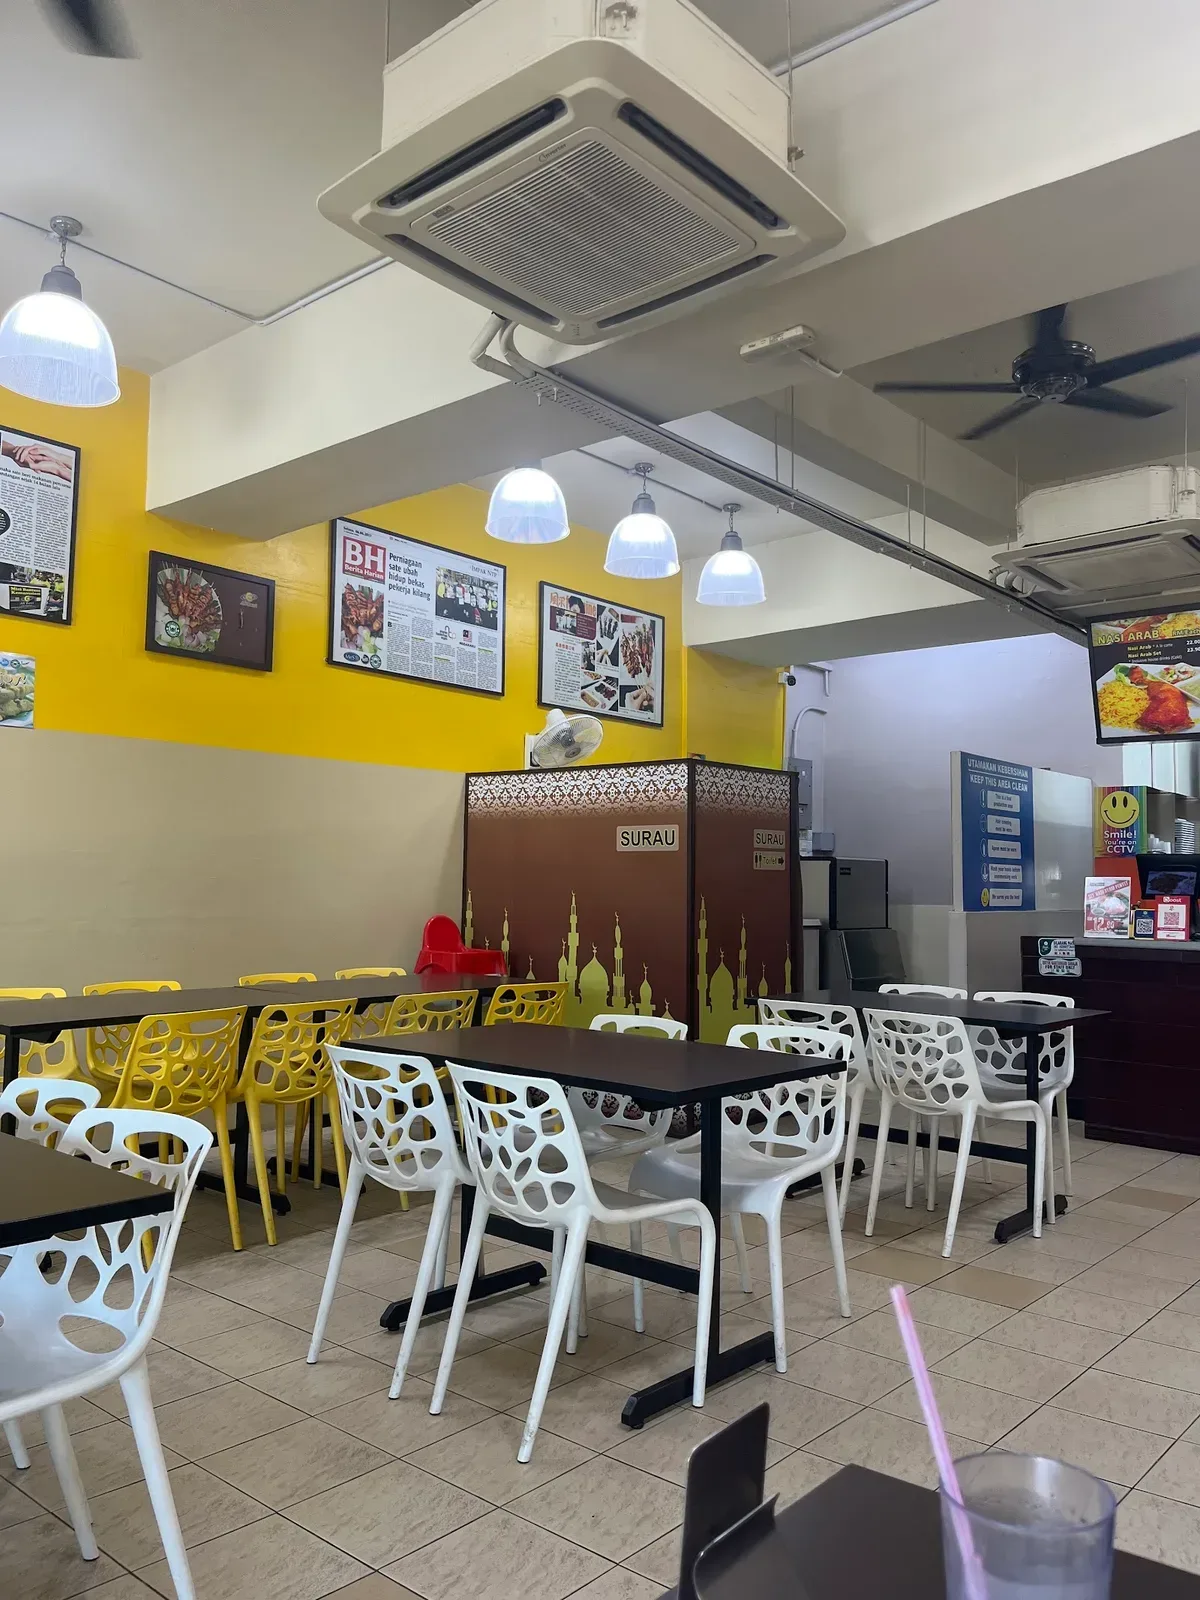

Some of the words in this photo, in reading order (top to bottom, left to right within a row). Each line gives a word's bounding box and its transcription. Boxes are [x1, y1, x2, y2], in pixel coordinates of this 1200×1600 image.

[345, 539, 384, 573] BH
[389, 552, 423, 568] Perniagaan
[344, 563, 364, 574] Berita
[364, 568, 384, 580] Harian
[388, 563, 402, 573] sate
[403, 566, 418, 577] ubah
[388, 571, 406, 584] hidup
[407, 576, 425, 588] bekas
[388, 583, 411, 596] pekerja
[412, 587, 431, 601] kilang
[1098, 633, 1125, 645] NASI
[1128, 629, 1160, 641] ARAB
[967, 758, 997, 772] UTAMAKAN
[997, 764, 1029, 779] KEBERSIHAN
[969, 773, 984, 785] KEEP
[985, 776, 997, 787] THIS
[997, 779, 1011, 789] AREA
[1011, 781, 1028, 792] CLEAN
[620, 830, 675, 847] SURAU
[755, 832, 784, 846] SURAU
[1104, 830, 1137, 839] Smile!
[1106, 845, 1134, 854] CCTV
[763, 856, 777, 865] Toilet
